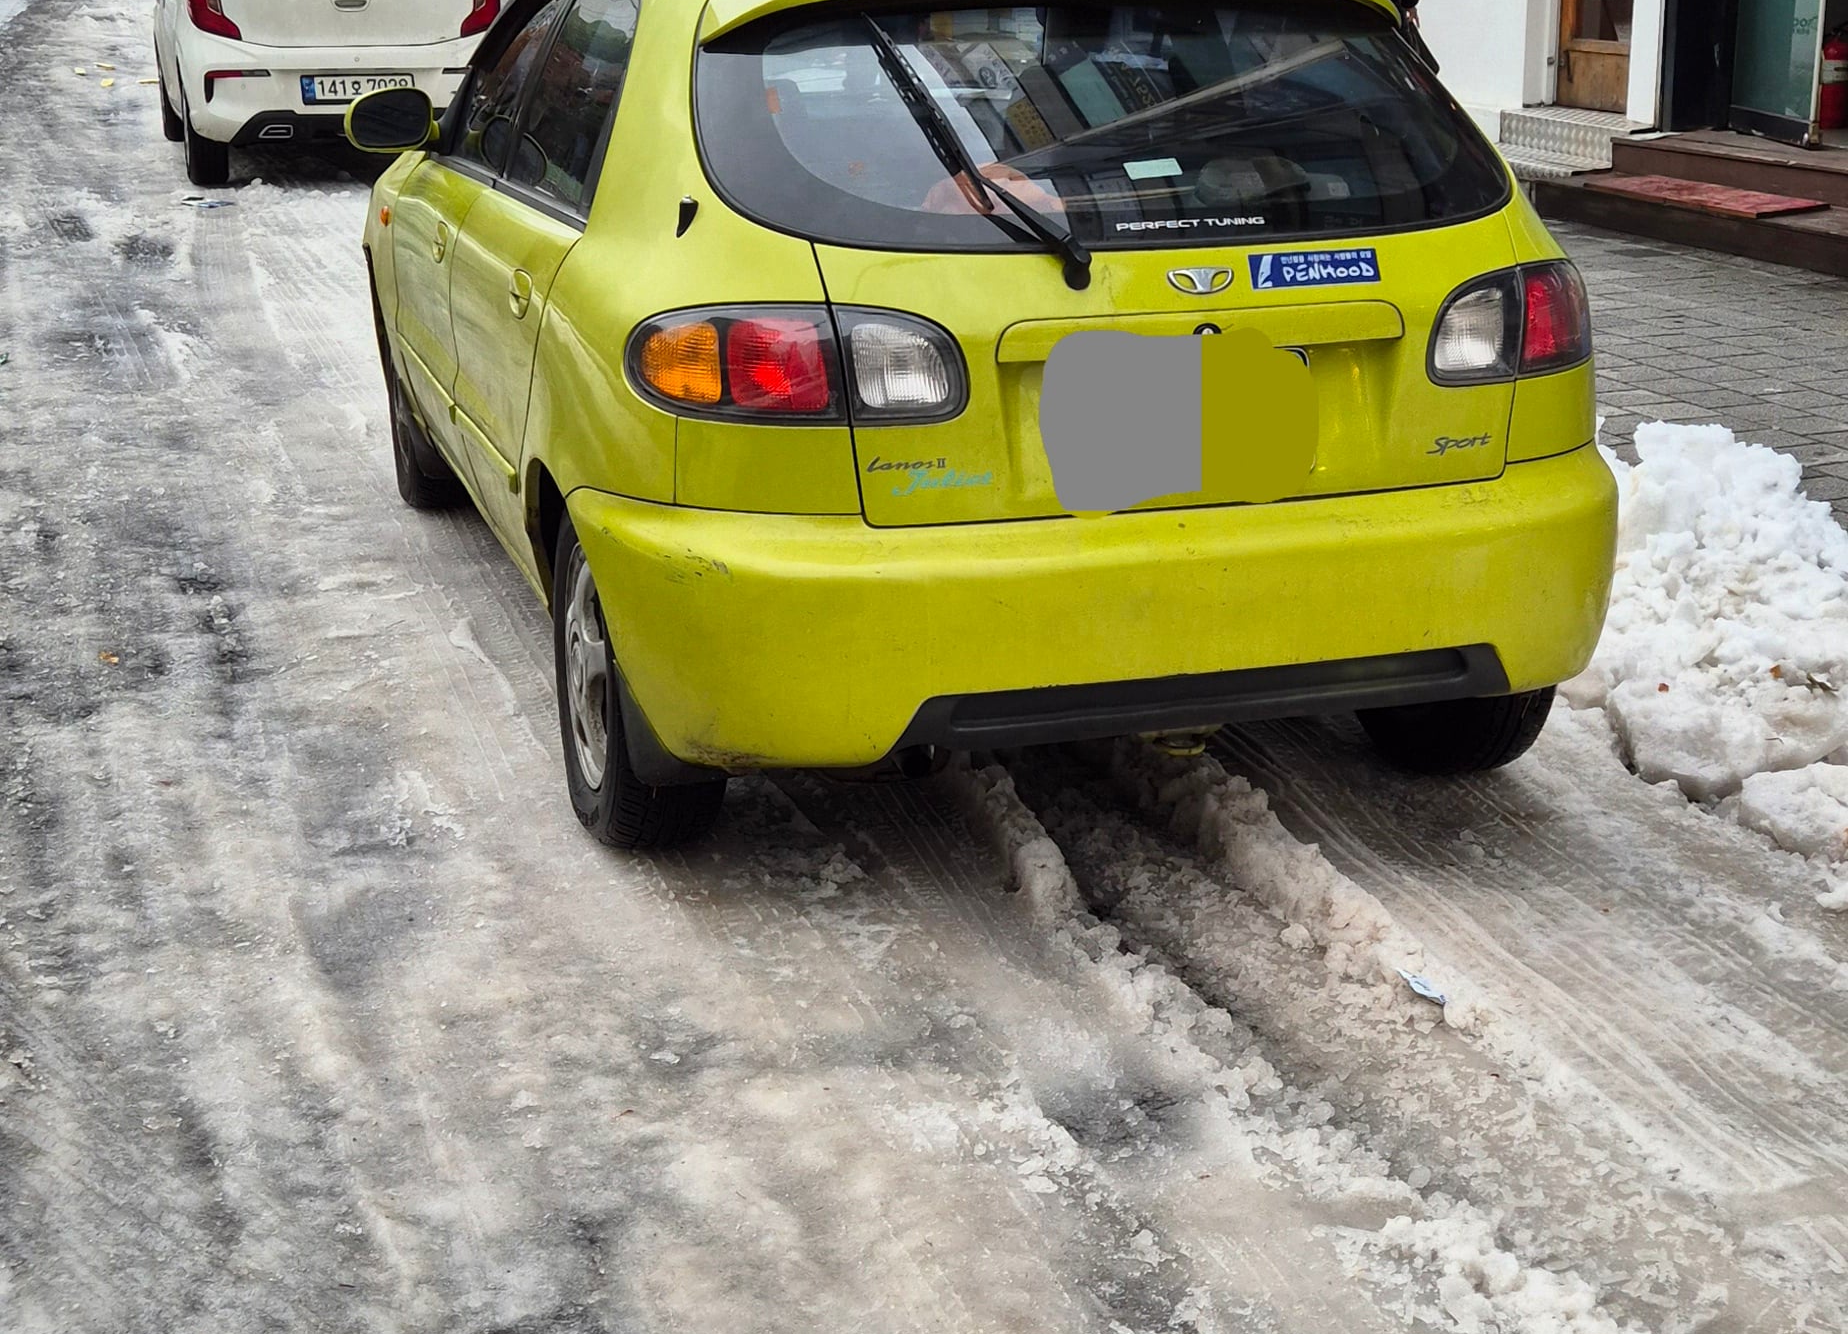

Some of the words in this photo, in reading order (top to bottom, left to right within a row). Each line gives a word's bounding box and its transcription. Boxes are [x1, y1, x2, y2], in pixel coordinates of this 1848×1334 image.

[318, 78, 362, 97] 141오
[1116, 219, 1200, 232] PERFECT
[1204, 216, 1265, 226] TUNING
[1283, 261, 1374, 282] PENHOOD
[1425, 432, 1492, 456] Sport
[866, 456, 935, 473] Lanos
